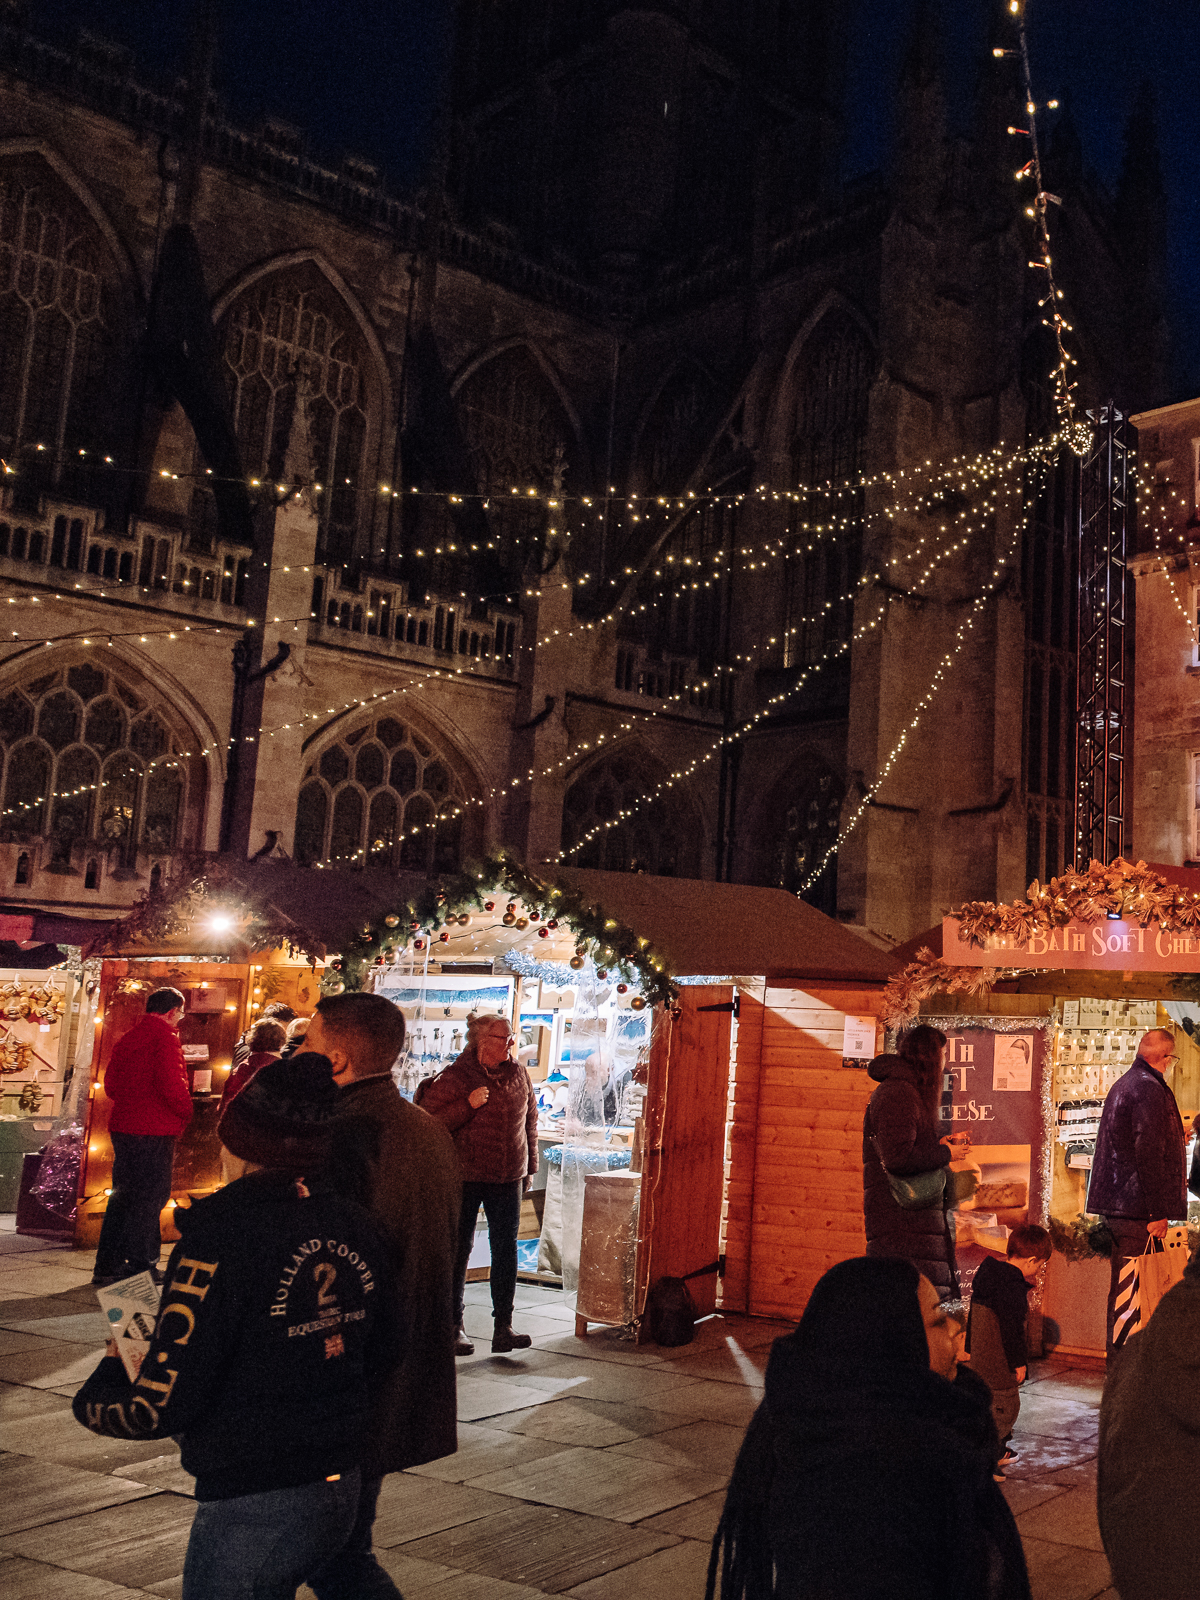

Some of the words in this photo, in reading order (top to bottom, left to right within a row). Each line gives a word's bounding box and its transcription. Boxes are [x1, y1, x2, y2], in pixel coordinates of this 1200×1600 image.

[983, 931, 1025, 953] HE
[1026, 926, 1086, 955] BATH
[1092, 926, 1152, 956] SOFT
[946, 1037, 975, 1063] TH
[942, 1066, 976, 1091] FT
[939, 1100, 995, 1121] EESE
[270, 1239, 322, 1317] HOLLAND
[327, 1239, 375, 1294] COOPER
[313, 1262, 337, 1306] 2
